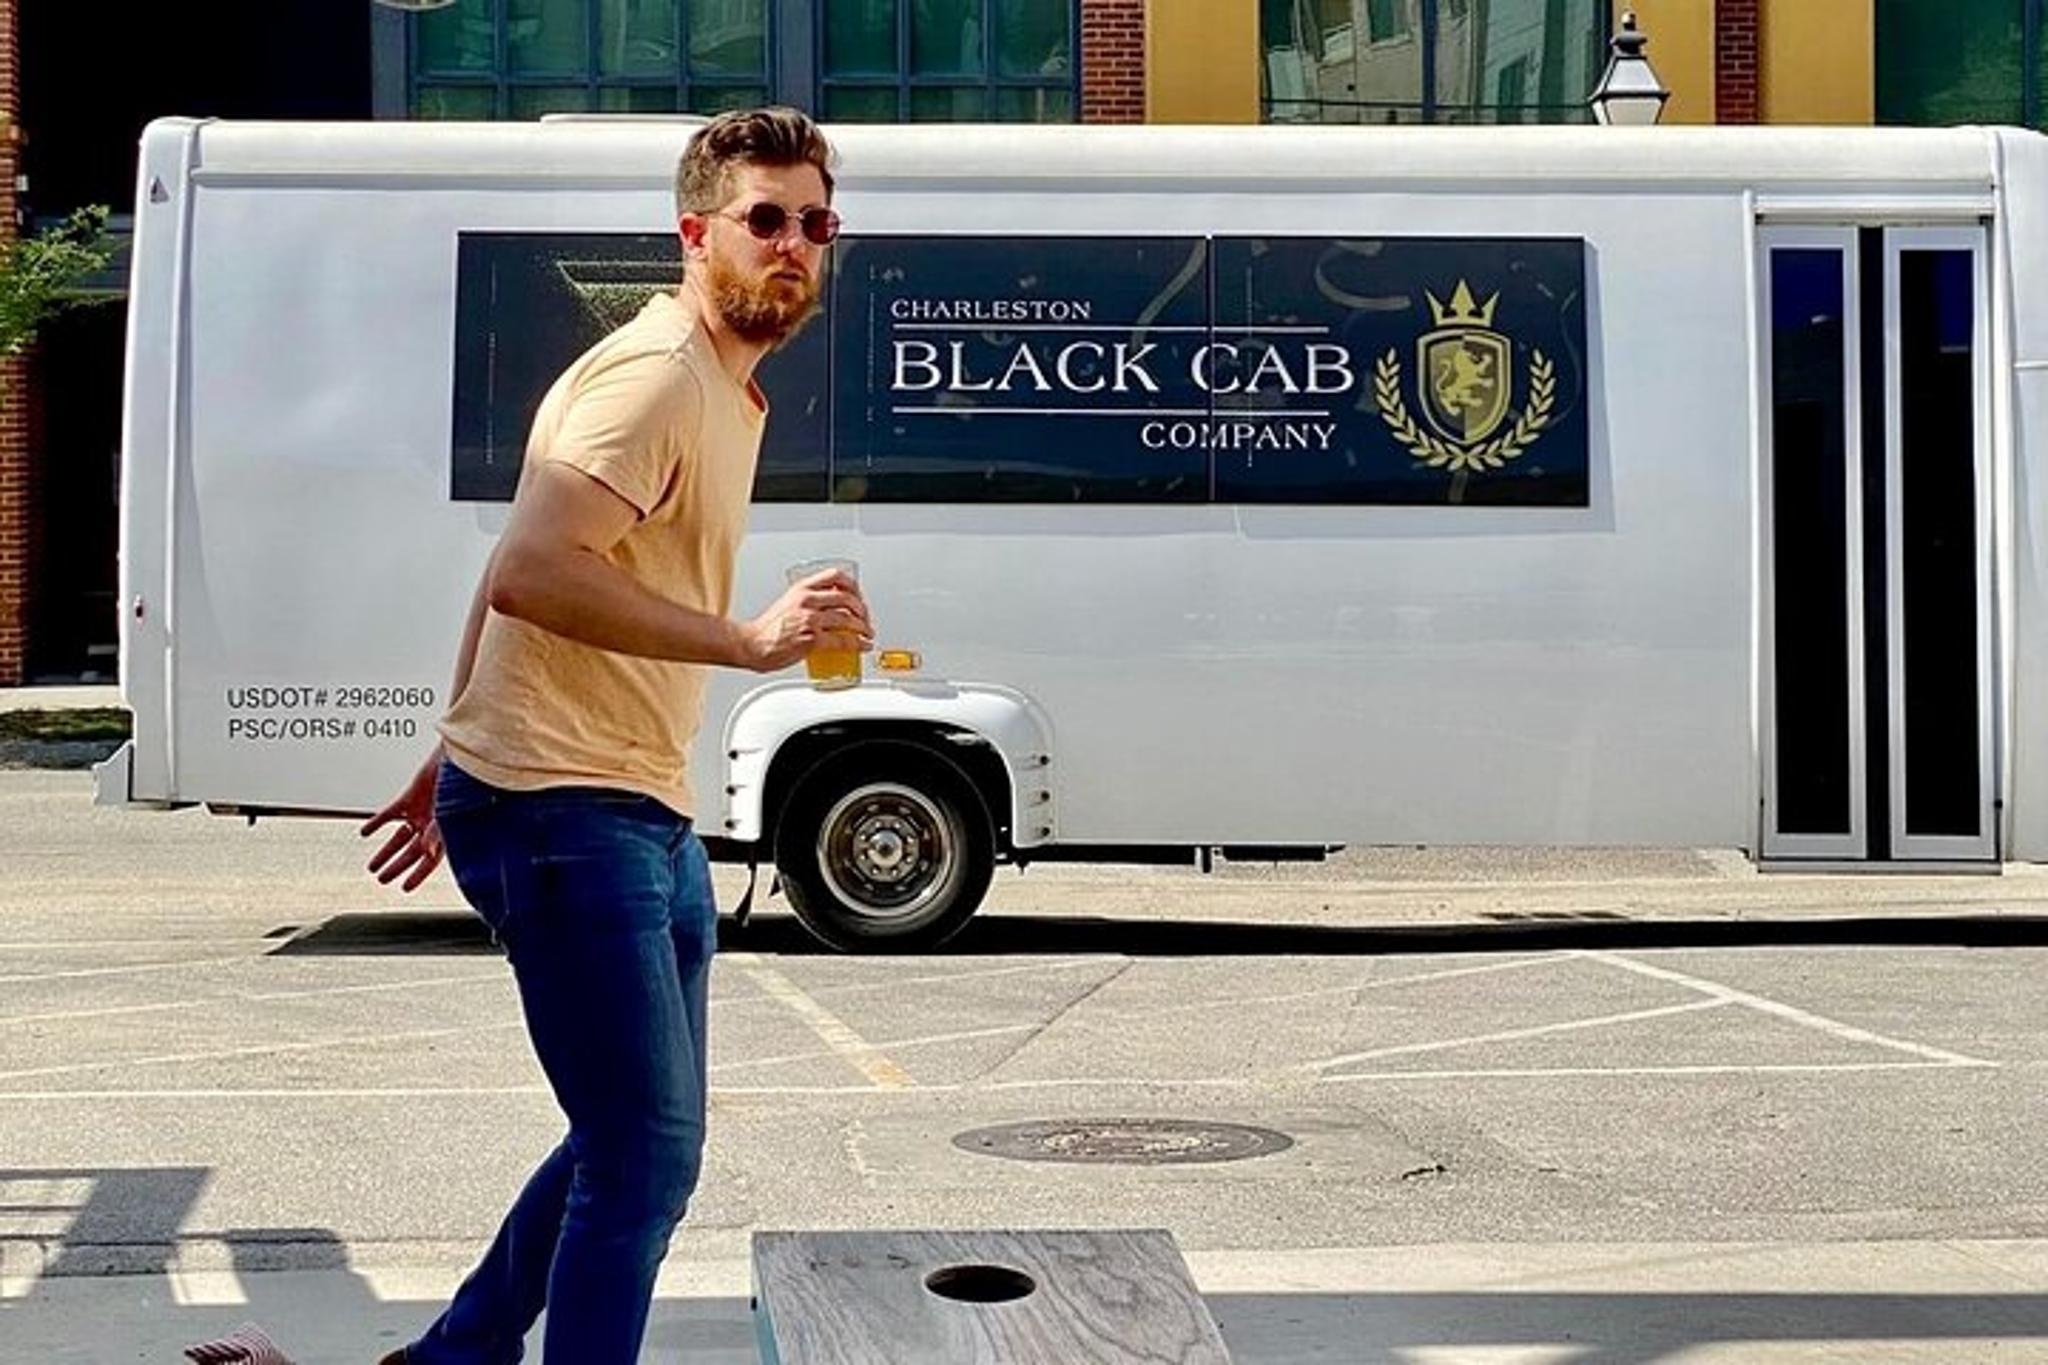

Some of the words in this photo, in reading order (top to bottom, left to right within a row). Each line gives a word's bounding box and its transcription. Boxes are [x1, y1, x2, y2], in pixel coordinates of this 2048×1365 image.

[891, 300, 1090, 319] CHARLESTON
[891, 341, 1157, 393] BLACK
[1191, 342, 1353, 394] CAB
[1141, 422, 1336, 449] COMPANY
[227, 687, 327, 708] USDOT#
[335, 687, 434, 708] 2962060
[228, 718, 356, 739] PSC/ORS#
[363, 718, 416, 738] 0410
